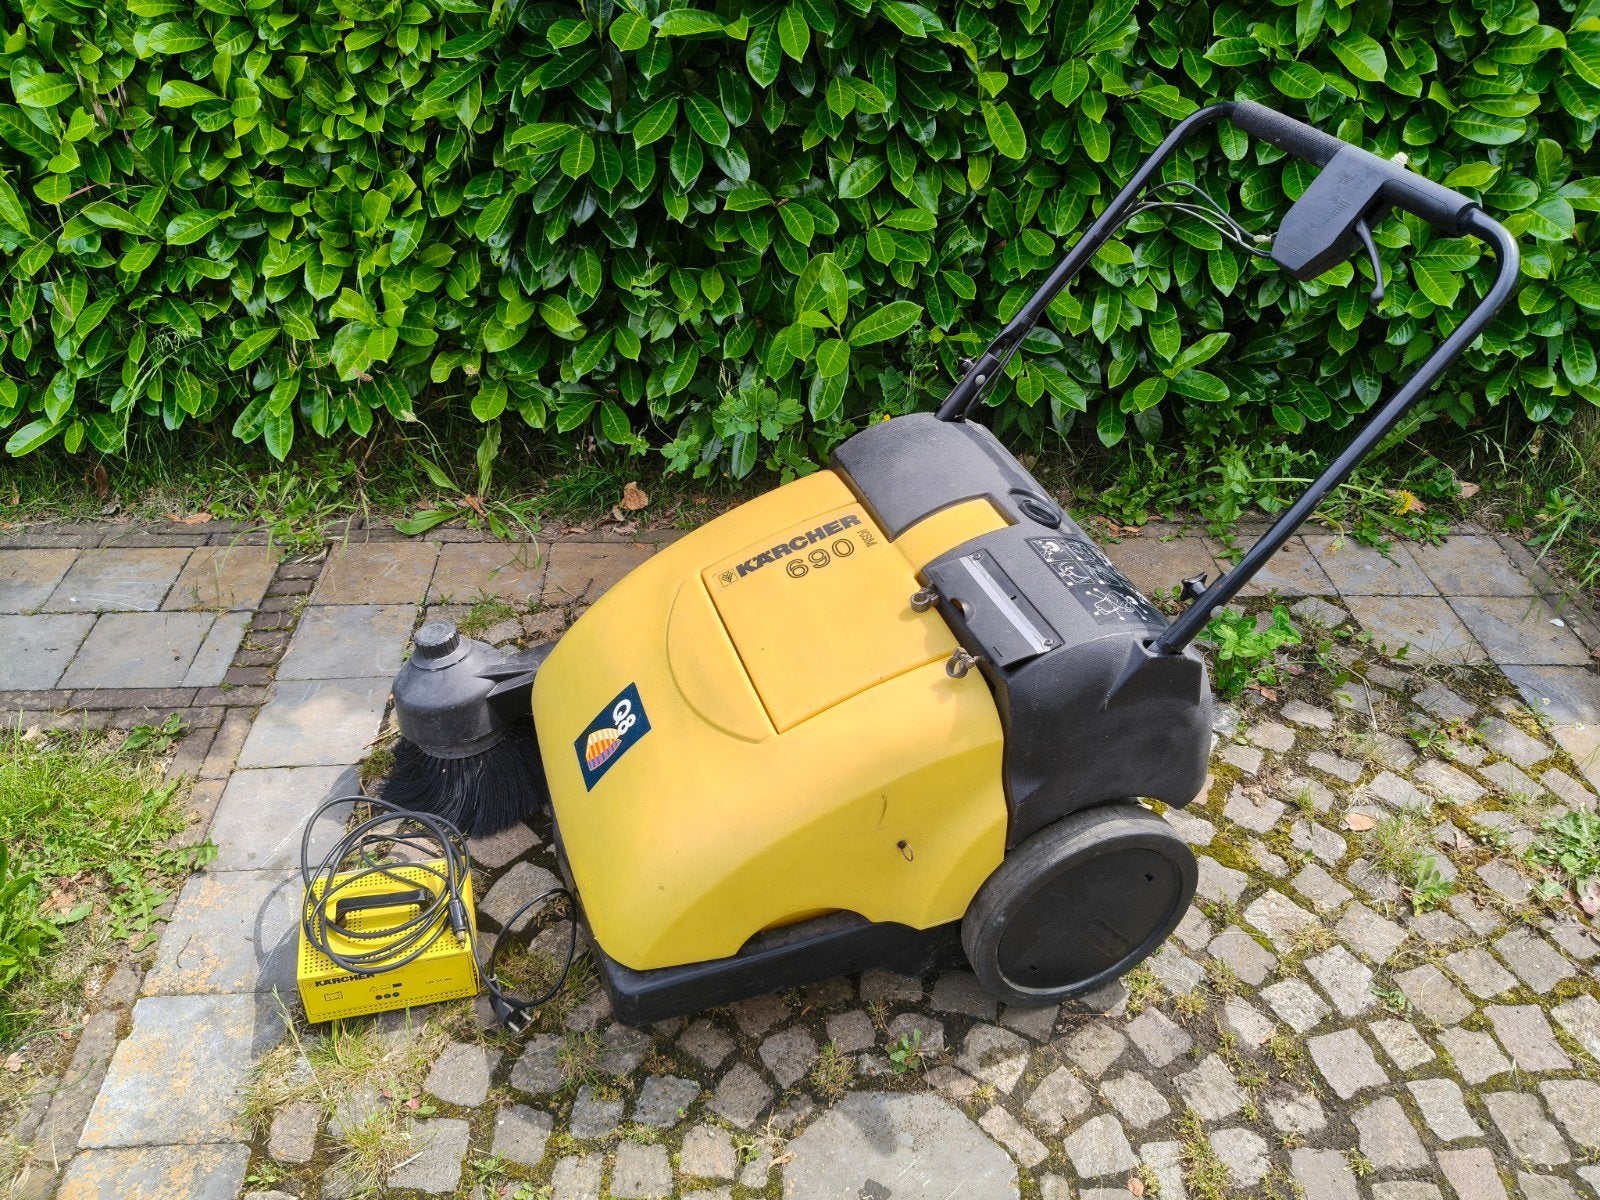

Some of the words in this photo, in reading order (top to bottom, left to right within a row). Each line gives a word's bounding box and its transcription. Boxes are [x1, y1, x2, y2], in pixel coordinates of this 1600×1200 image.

[736, 514, 862, 578] KÄRCHER
[857, 528, 878, 548] KSM
[786, 538, 855, 579] 690
[613, 699, 637, 736] Q8
